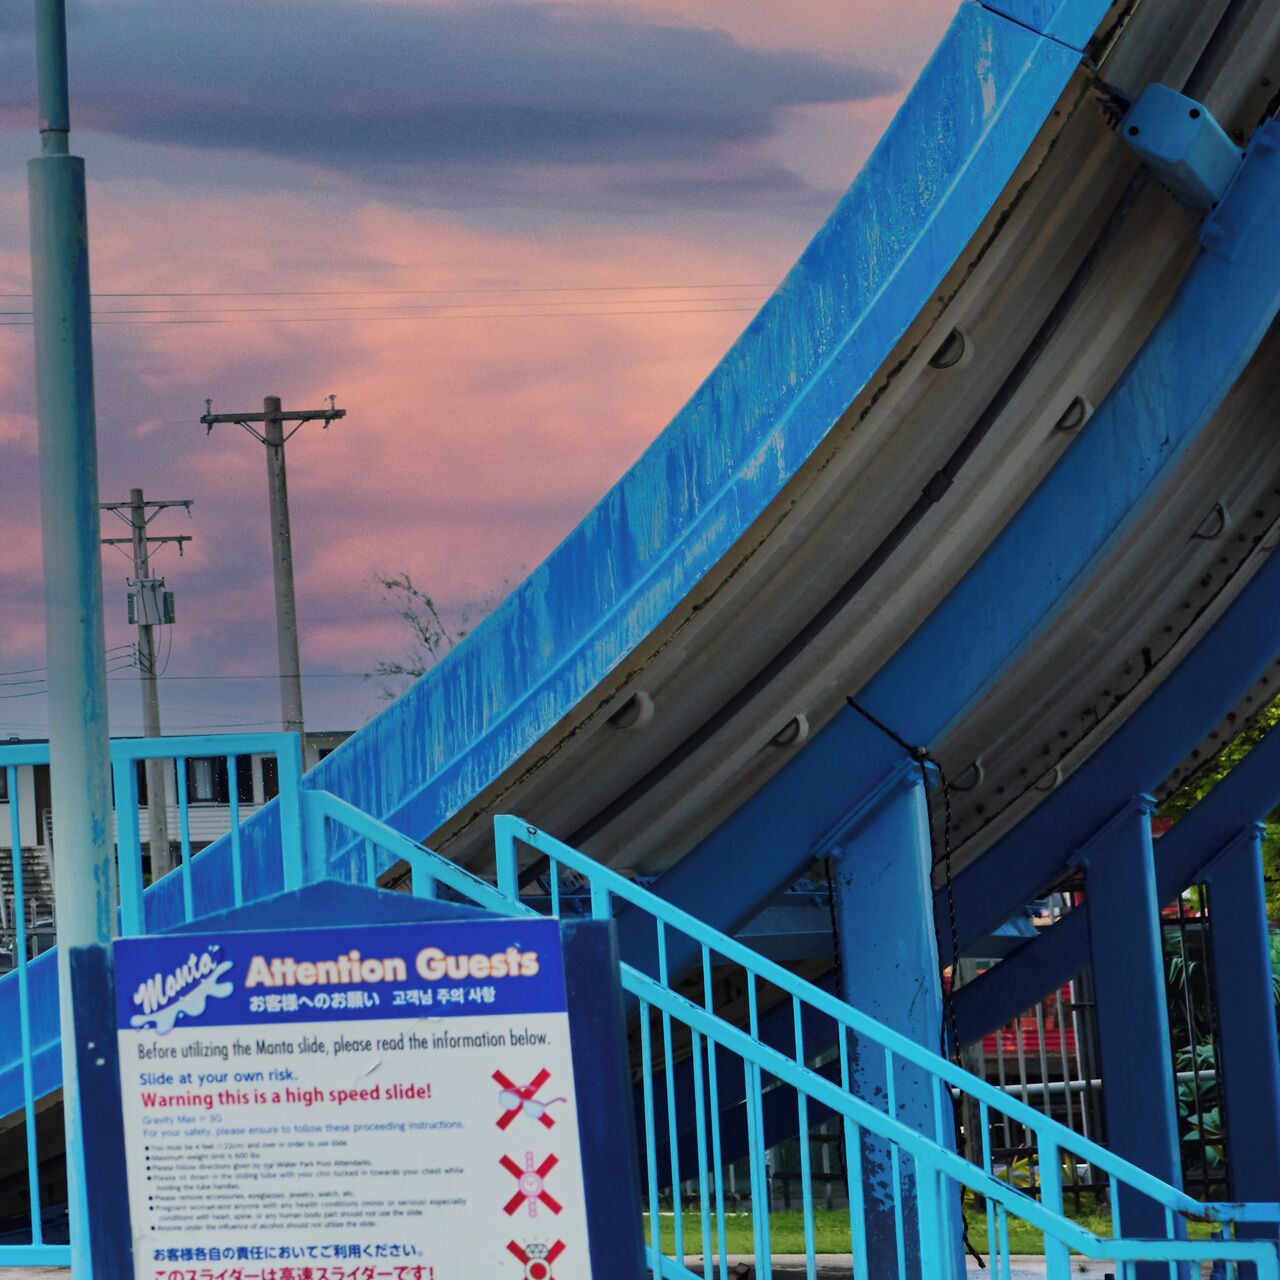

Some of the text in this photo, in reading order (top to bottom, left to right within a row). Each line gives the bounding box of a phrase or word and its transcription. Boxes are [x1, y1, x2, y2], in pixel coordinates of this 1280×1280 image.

[244, 946, 540, 989] Attention Guests
[133, 953, 216, 1015] Manta
[249, 990, 380, 1012] お客様へのお願い
[138, 1027, 551, 1060] Before utilizing the Manta slide, please read the information below.
[140, 1068, 298, 1086] Slide at your own risk.
[141, 1083, 432, 1110] Warning this is a high speed slide!
[143, 1129, 157, 1137] For
[161, 1129, 180, 1138] your
[216, 1127, 244, 1136] please
[249, 1126, 278, 1134] ensure
[295, 1124, 322, 1133] follow
[326, 1123, 349, 1131] these
[354, 1122, 406, 1133] proceeding
[409, 1121, 464, 1129] instructions.
